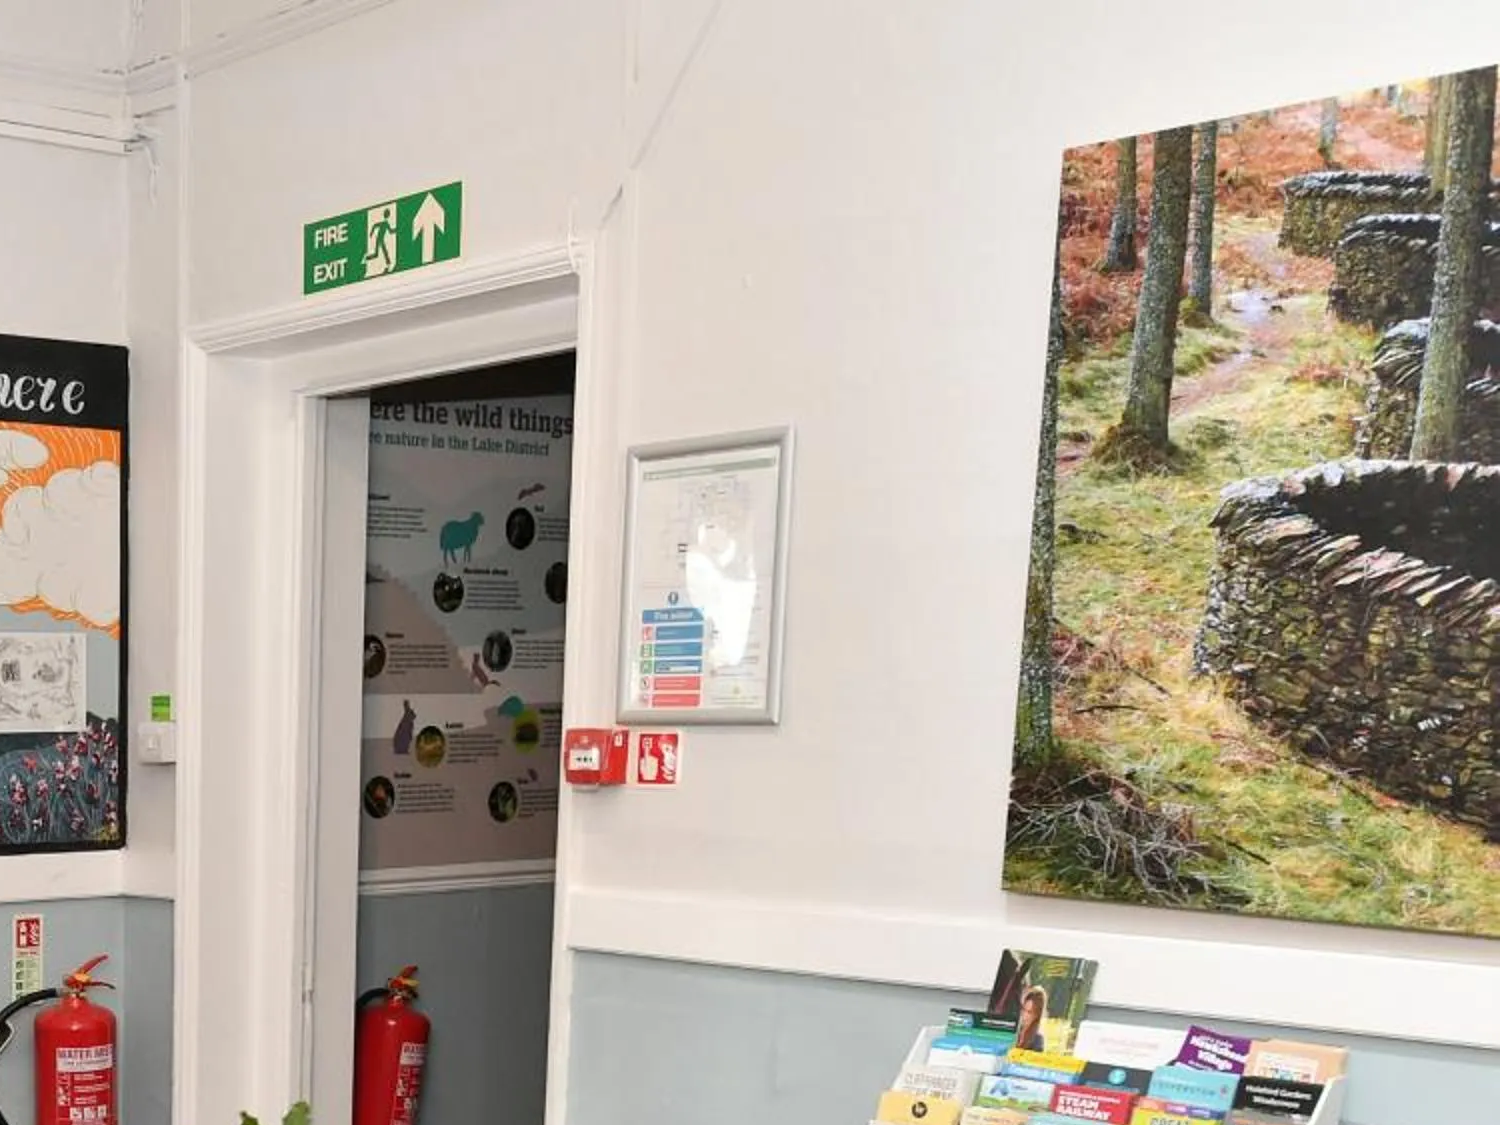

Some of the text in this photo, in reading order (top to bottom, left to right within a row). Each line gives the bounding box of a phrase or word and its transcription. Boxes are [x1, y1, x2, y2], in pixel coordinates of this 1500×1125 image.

[314, 222, 348, 249] FIRE
[313, 257, 346, 285] EXIT
[370, 401, 573, 438] ere the wild things
[385, 432, 429, 448] nature
[432, 433, 445, 448] in
[448, 435, 469, 450] the
[472, 438, 502, 452] Lake
[505, 439, 549, 456] District
